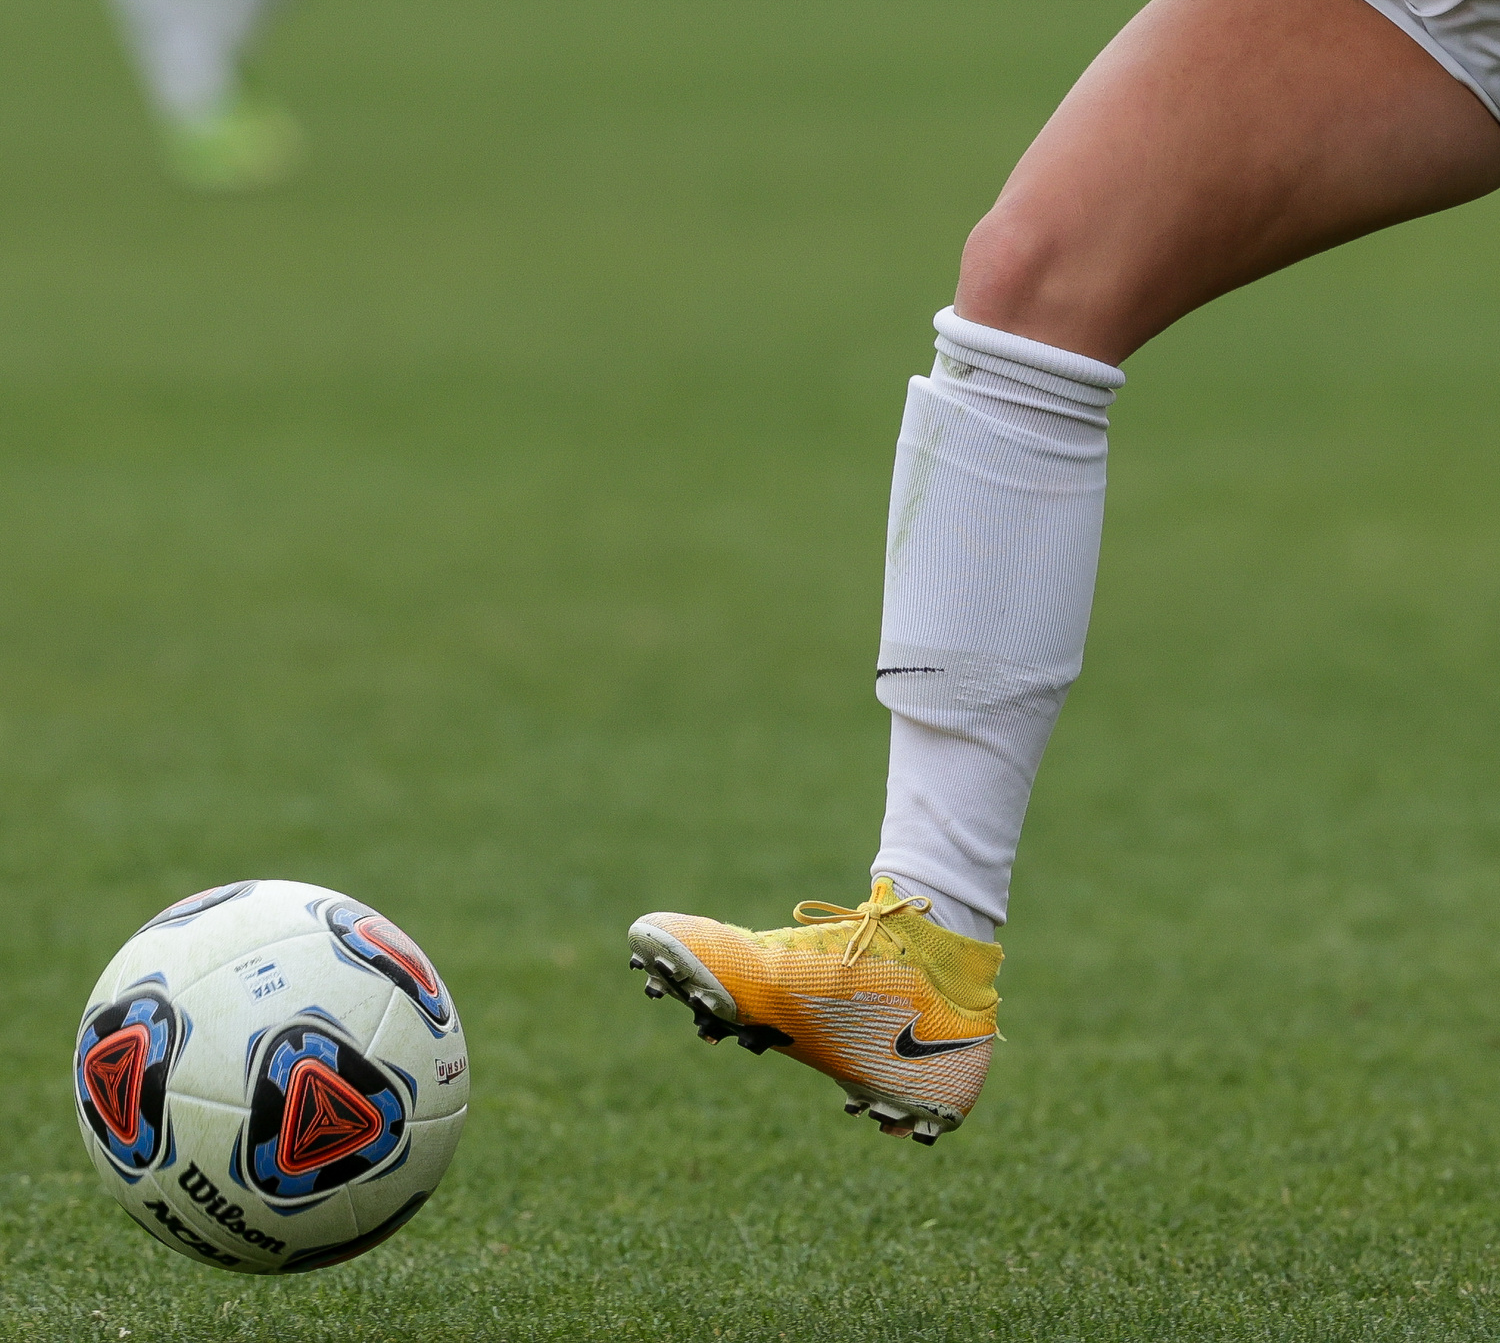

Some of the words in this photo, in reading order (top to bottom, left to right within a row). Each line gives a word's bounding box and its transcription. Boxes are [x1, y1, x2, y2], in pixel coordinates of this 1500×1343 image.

[253, 976, 285, 1000] FIFA
[851, 990, 914, 1009] MERCURIAL
[178, 1160, 286, 1255] Wilson
